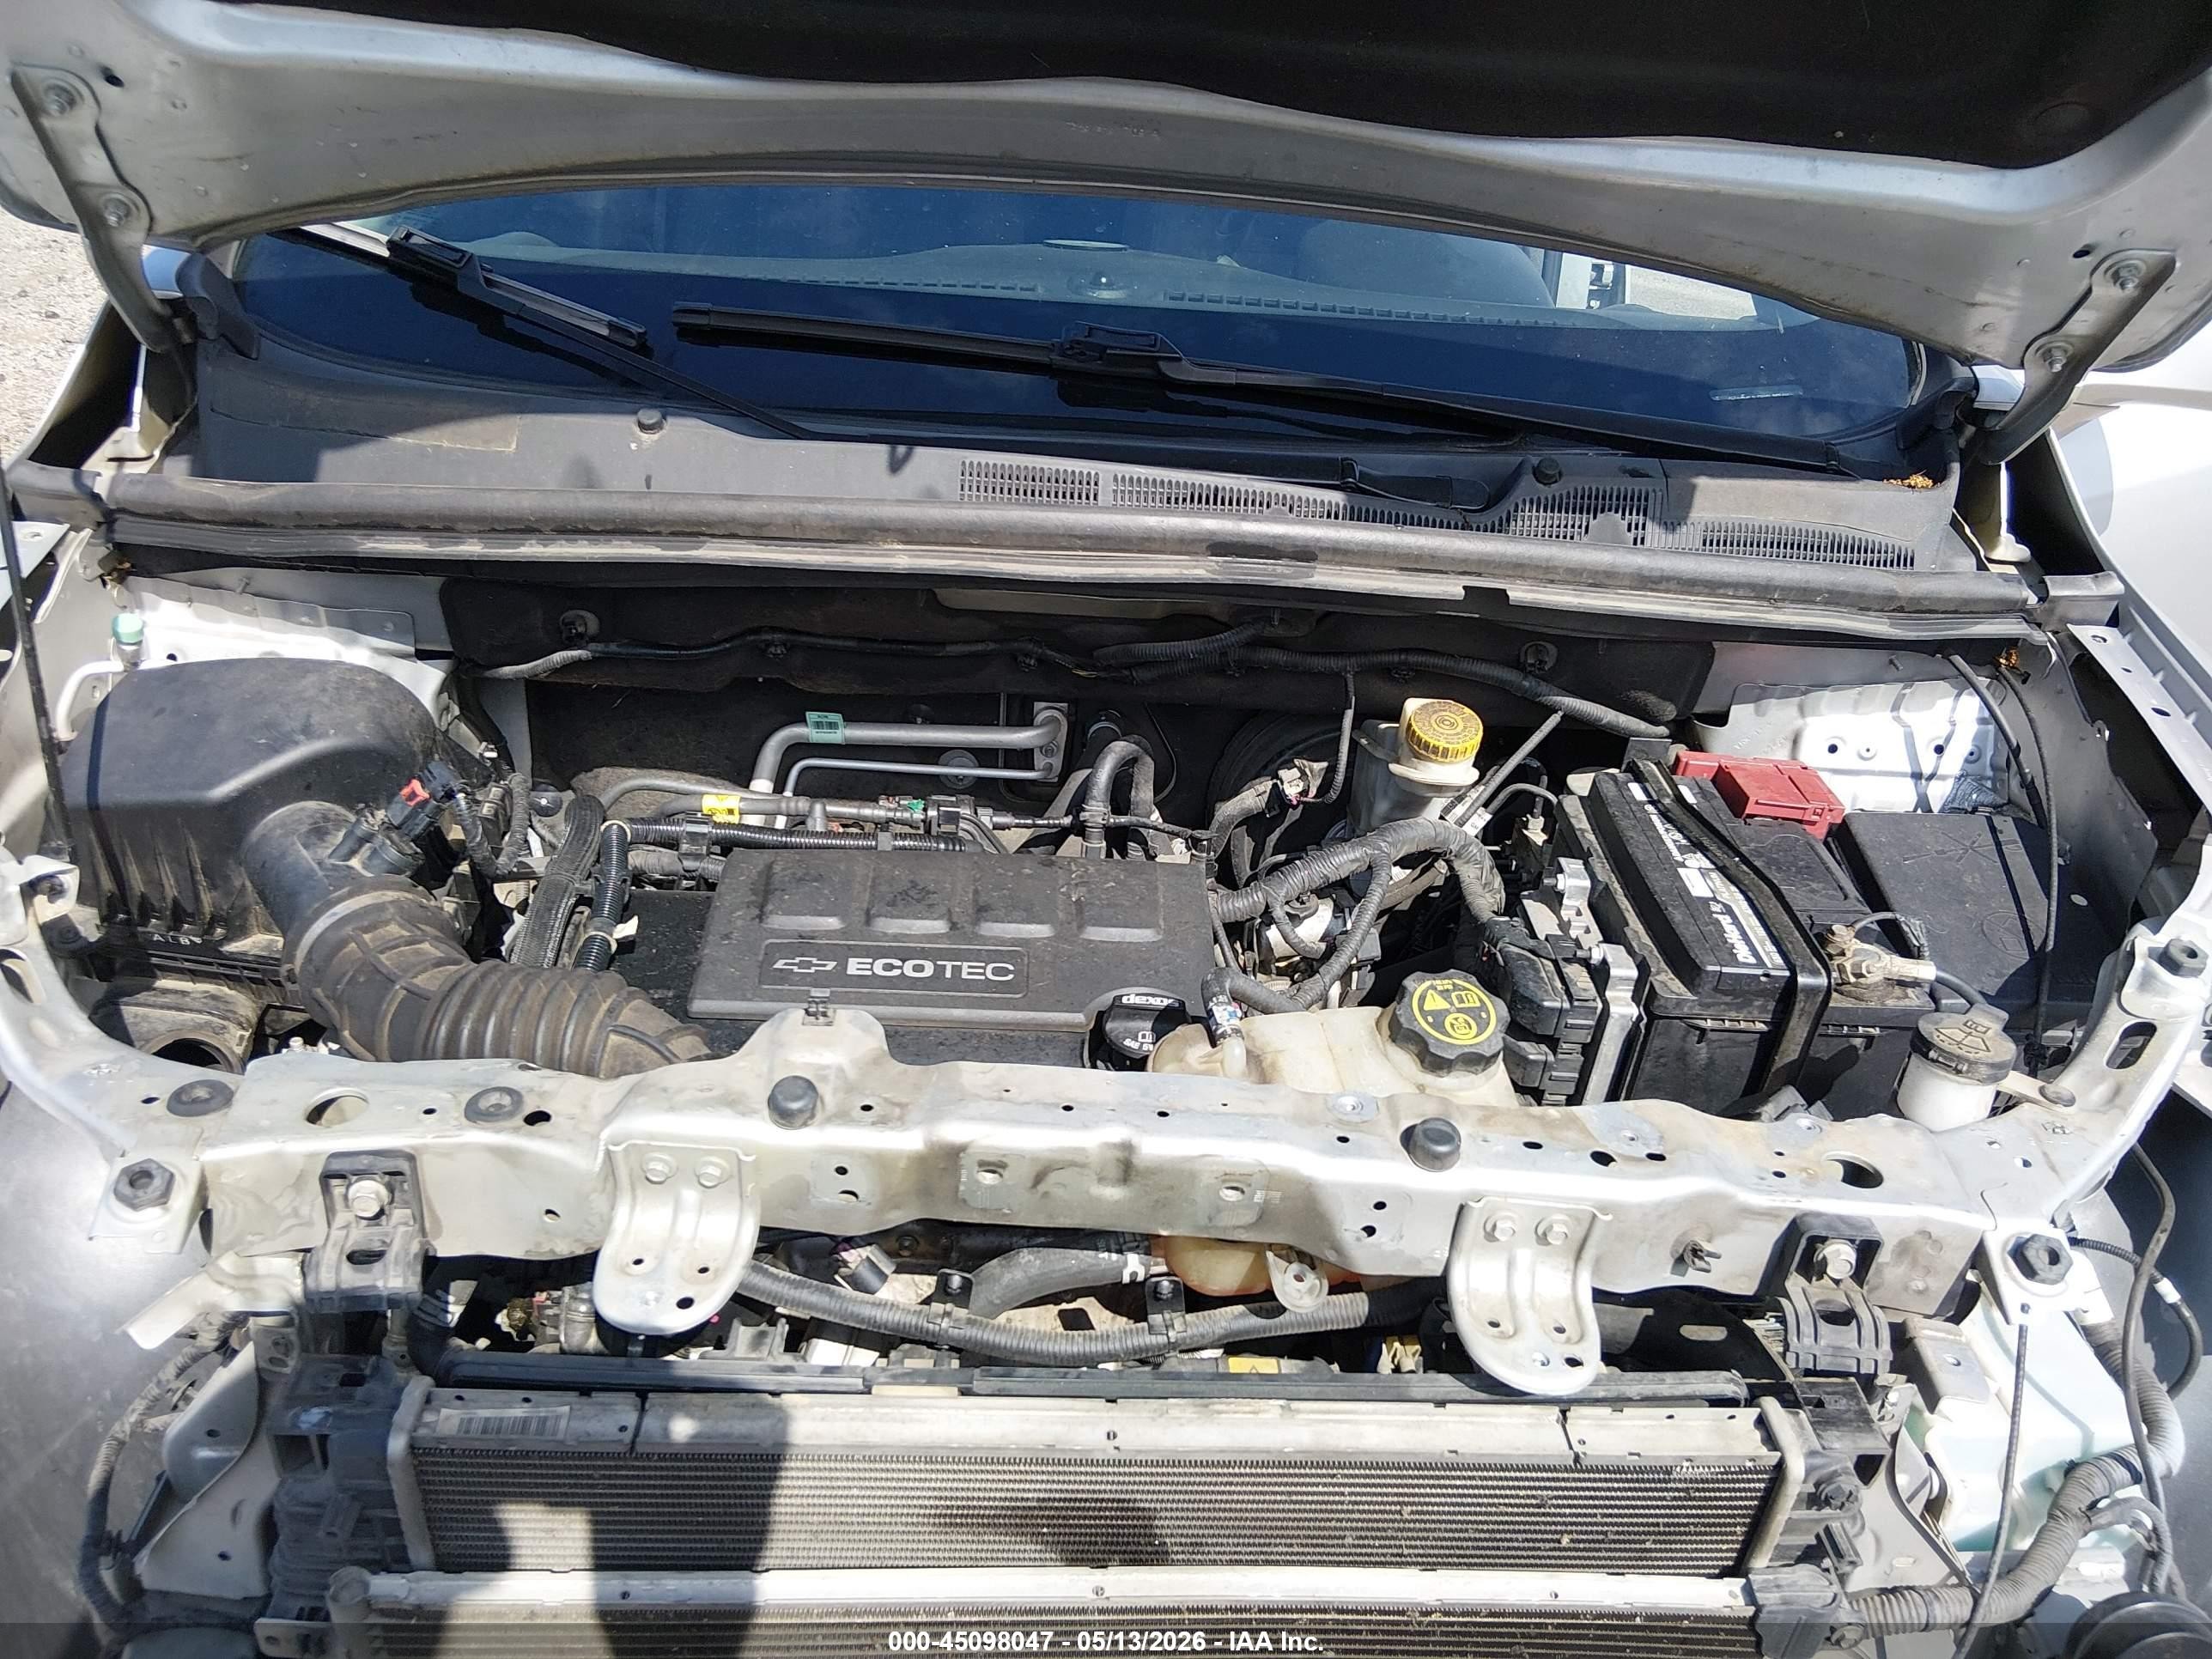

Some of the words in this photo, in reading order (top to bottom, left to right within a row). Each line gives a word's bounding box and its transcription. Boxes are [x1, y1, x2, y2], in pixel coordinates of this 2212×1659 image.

[1711, 913, 1758, 963] DieHard
[846, 957, 1015, 981] ECOTEC
[1121, 994, 1180, 1007] dexos
